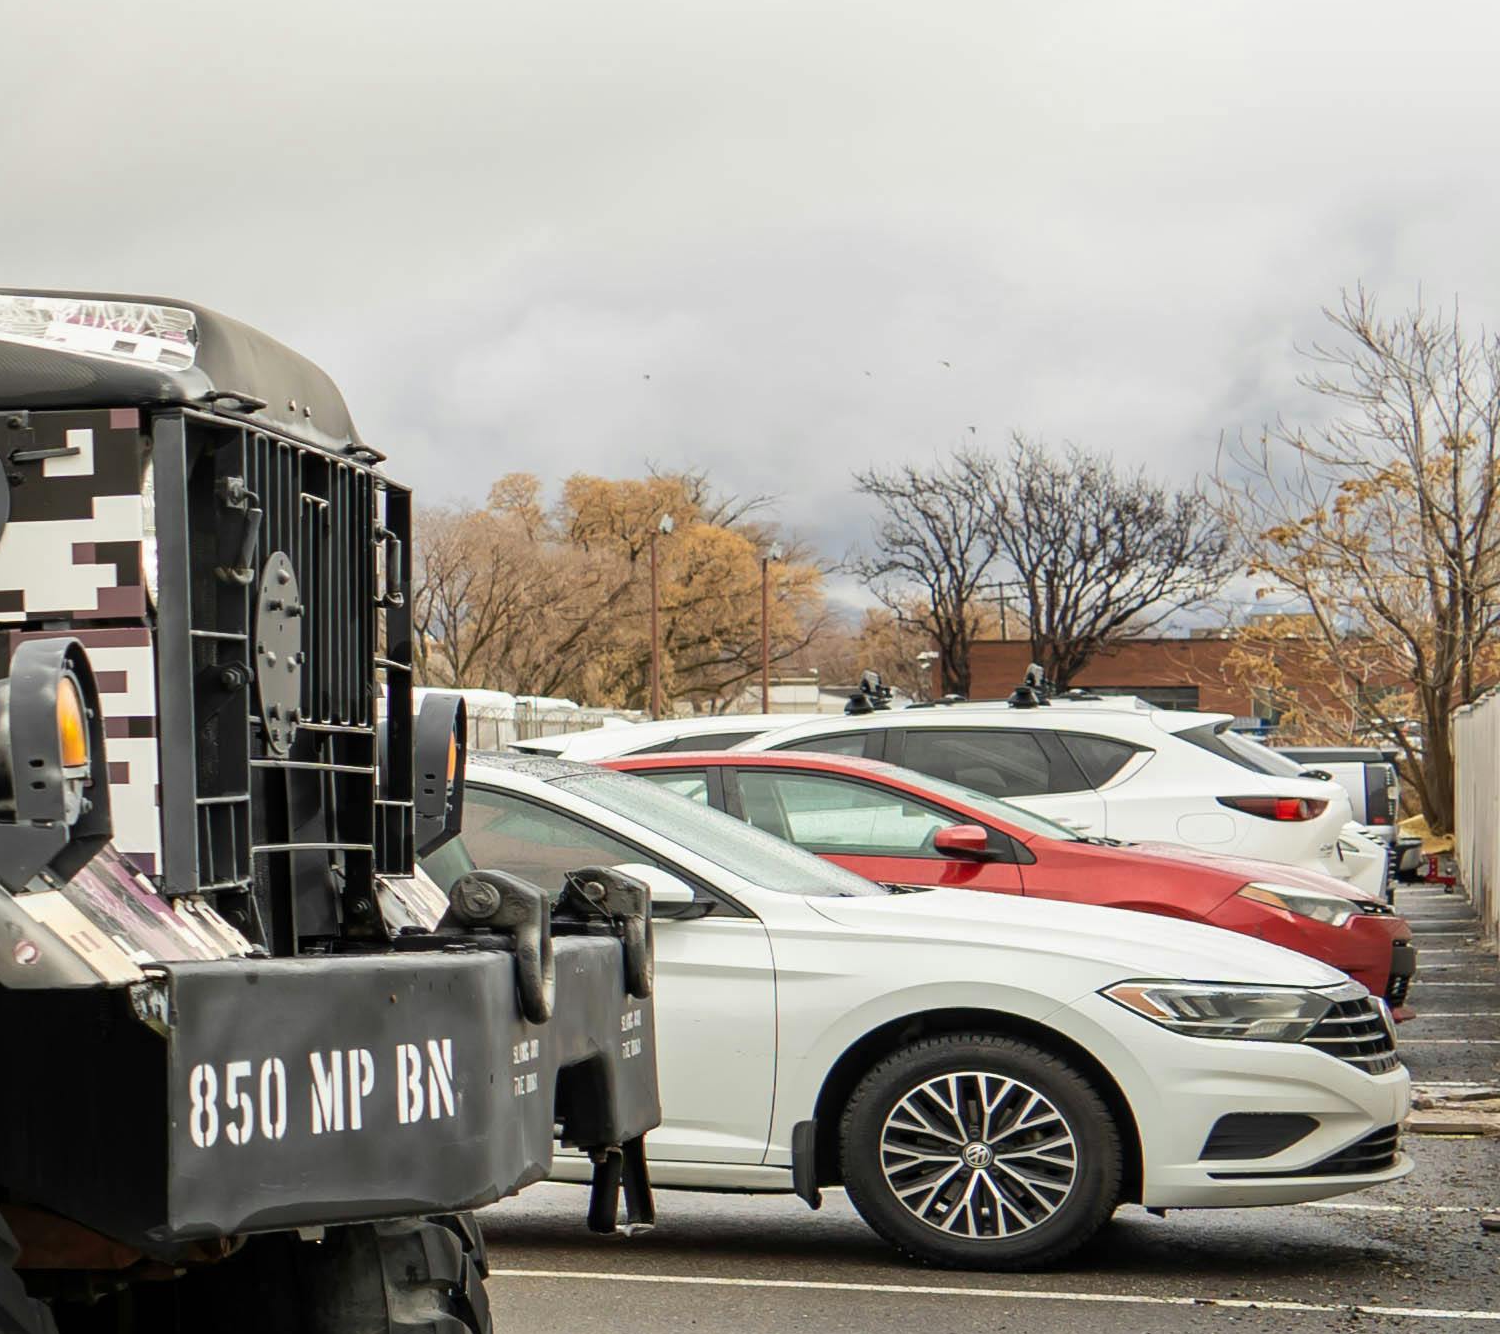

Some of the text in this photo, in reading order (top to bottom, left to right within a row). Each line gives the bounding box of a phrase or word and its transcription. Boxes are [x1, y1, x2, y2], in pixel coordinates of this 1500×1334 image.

[189, 1038, 455, 1148] 850 MP BN
